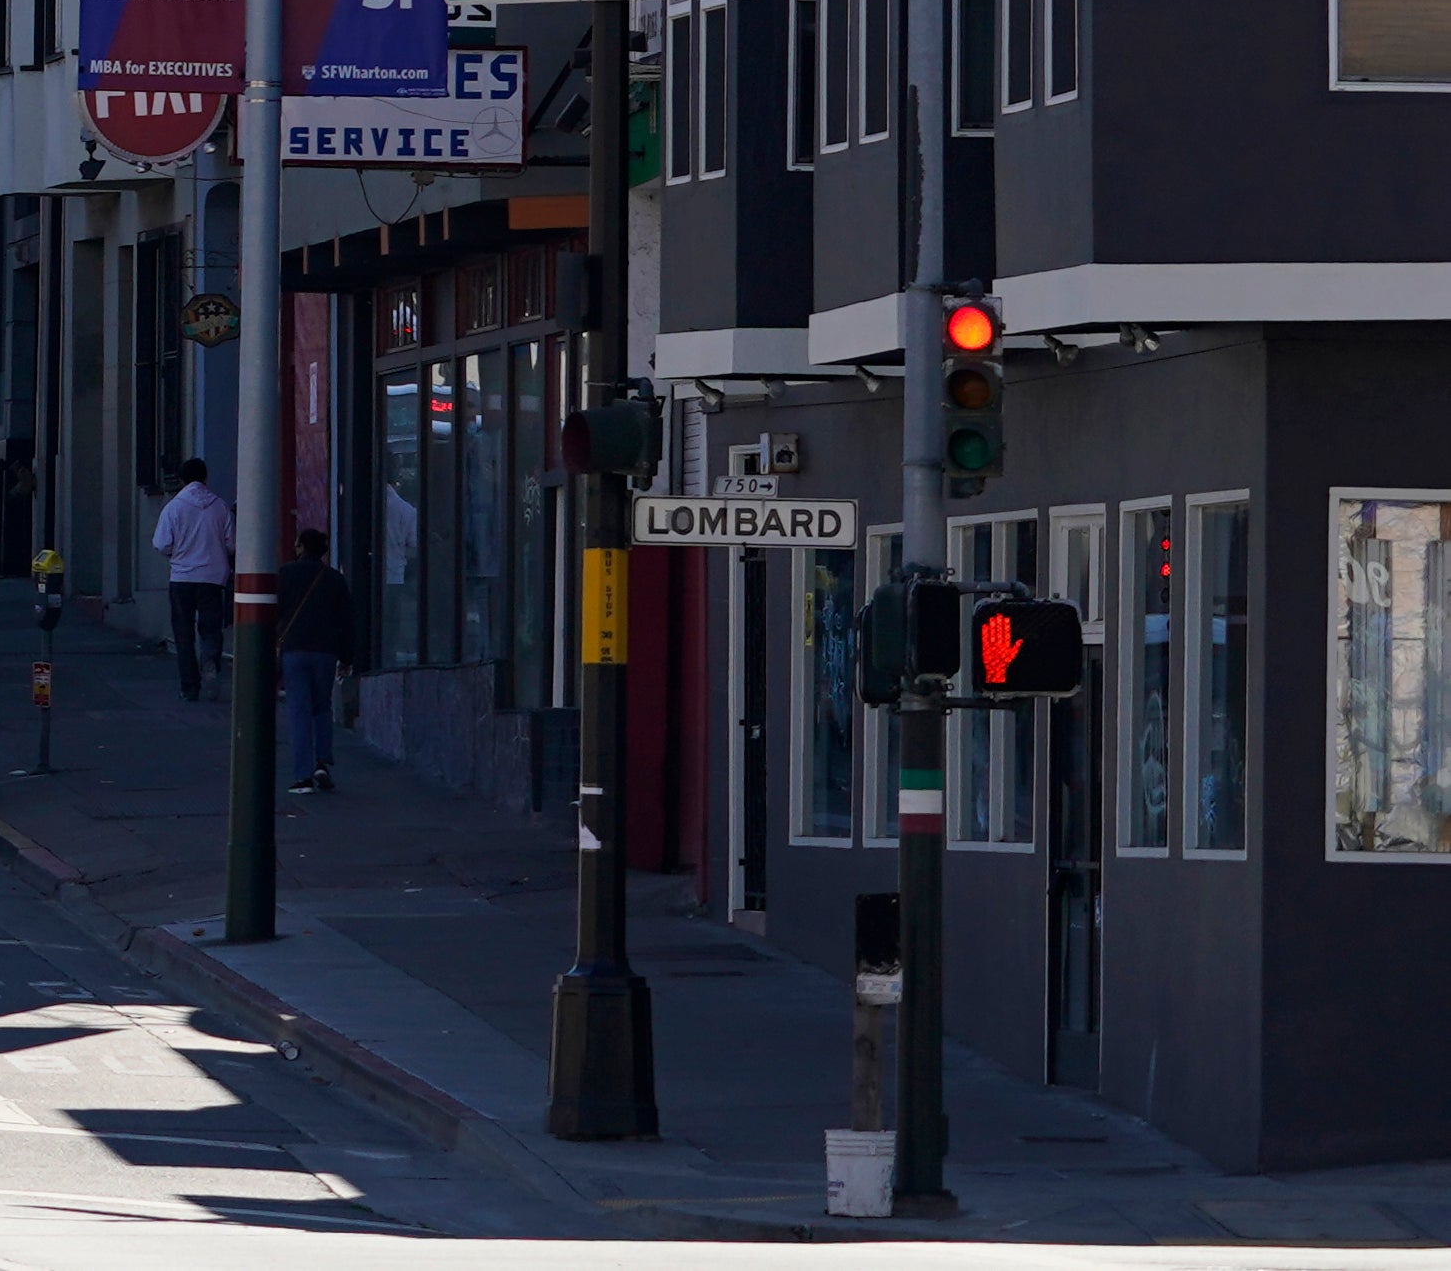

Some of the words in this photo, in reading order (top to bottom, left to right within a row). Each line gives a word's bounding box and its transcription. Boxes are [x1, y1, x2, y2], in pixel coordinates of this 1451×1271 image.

[90, 59, 122, 74] MBA
[126, 60, 145, 75] for
[148, 60, 233, 77] EXECUTIVES
[321, 64, 428, 80] SFWharton.com
[289, 126, 470, 157] SERVICE
[723, 479, 758, 493] 750
[648, 506, 842, 538] LOMBARD
